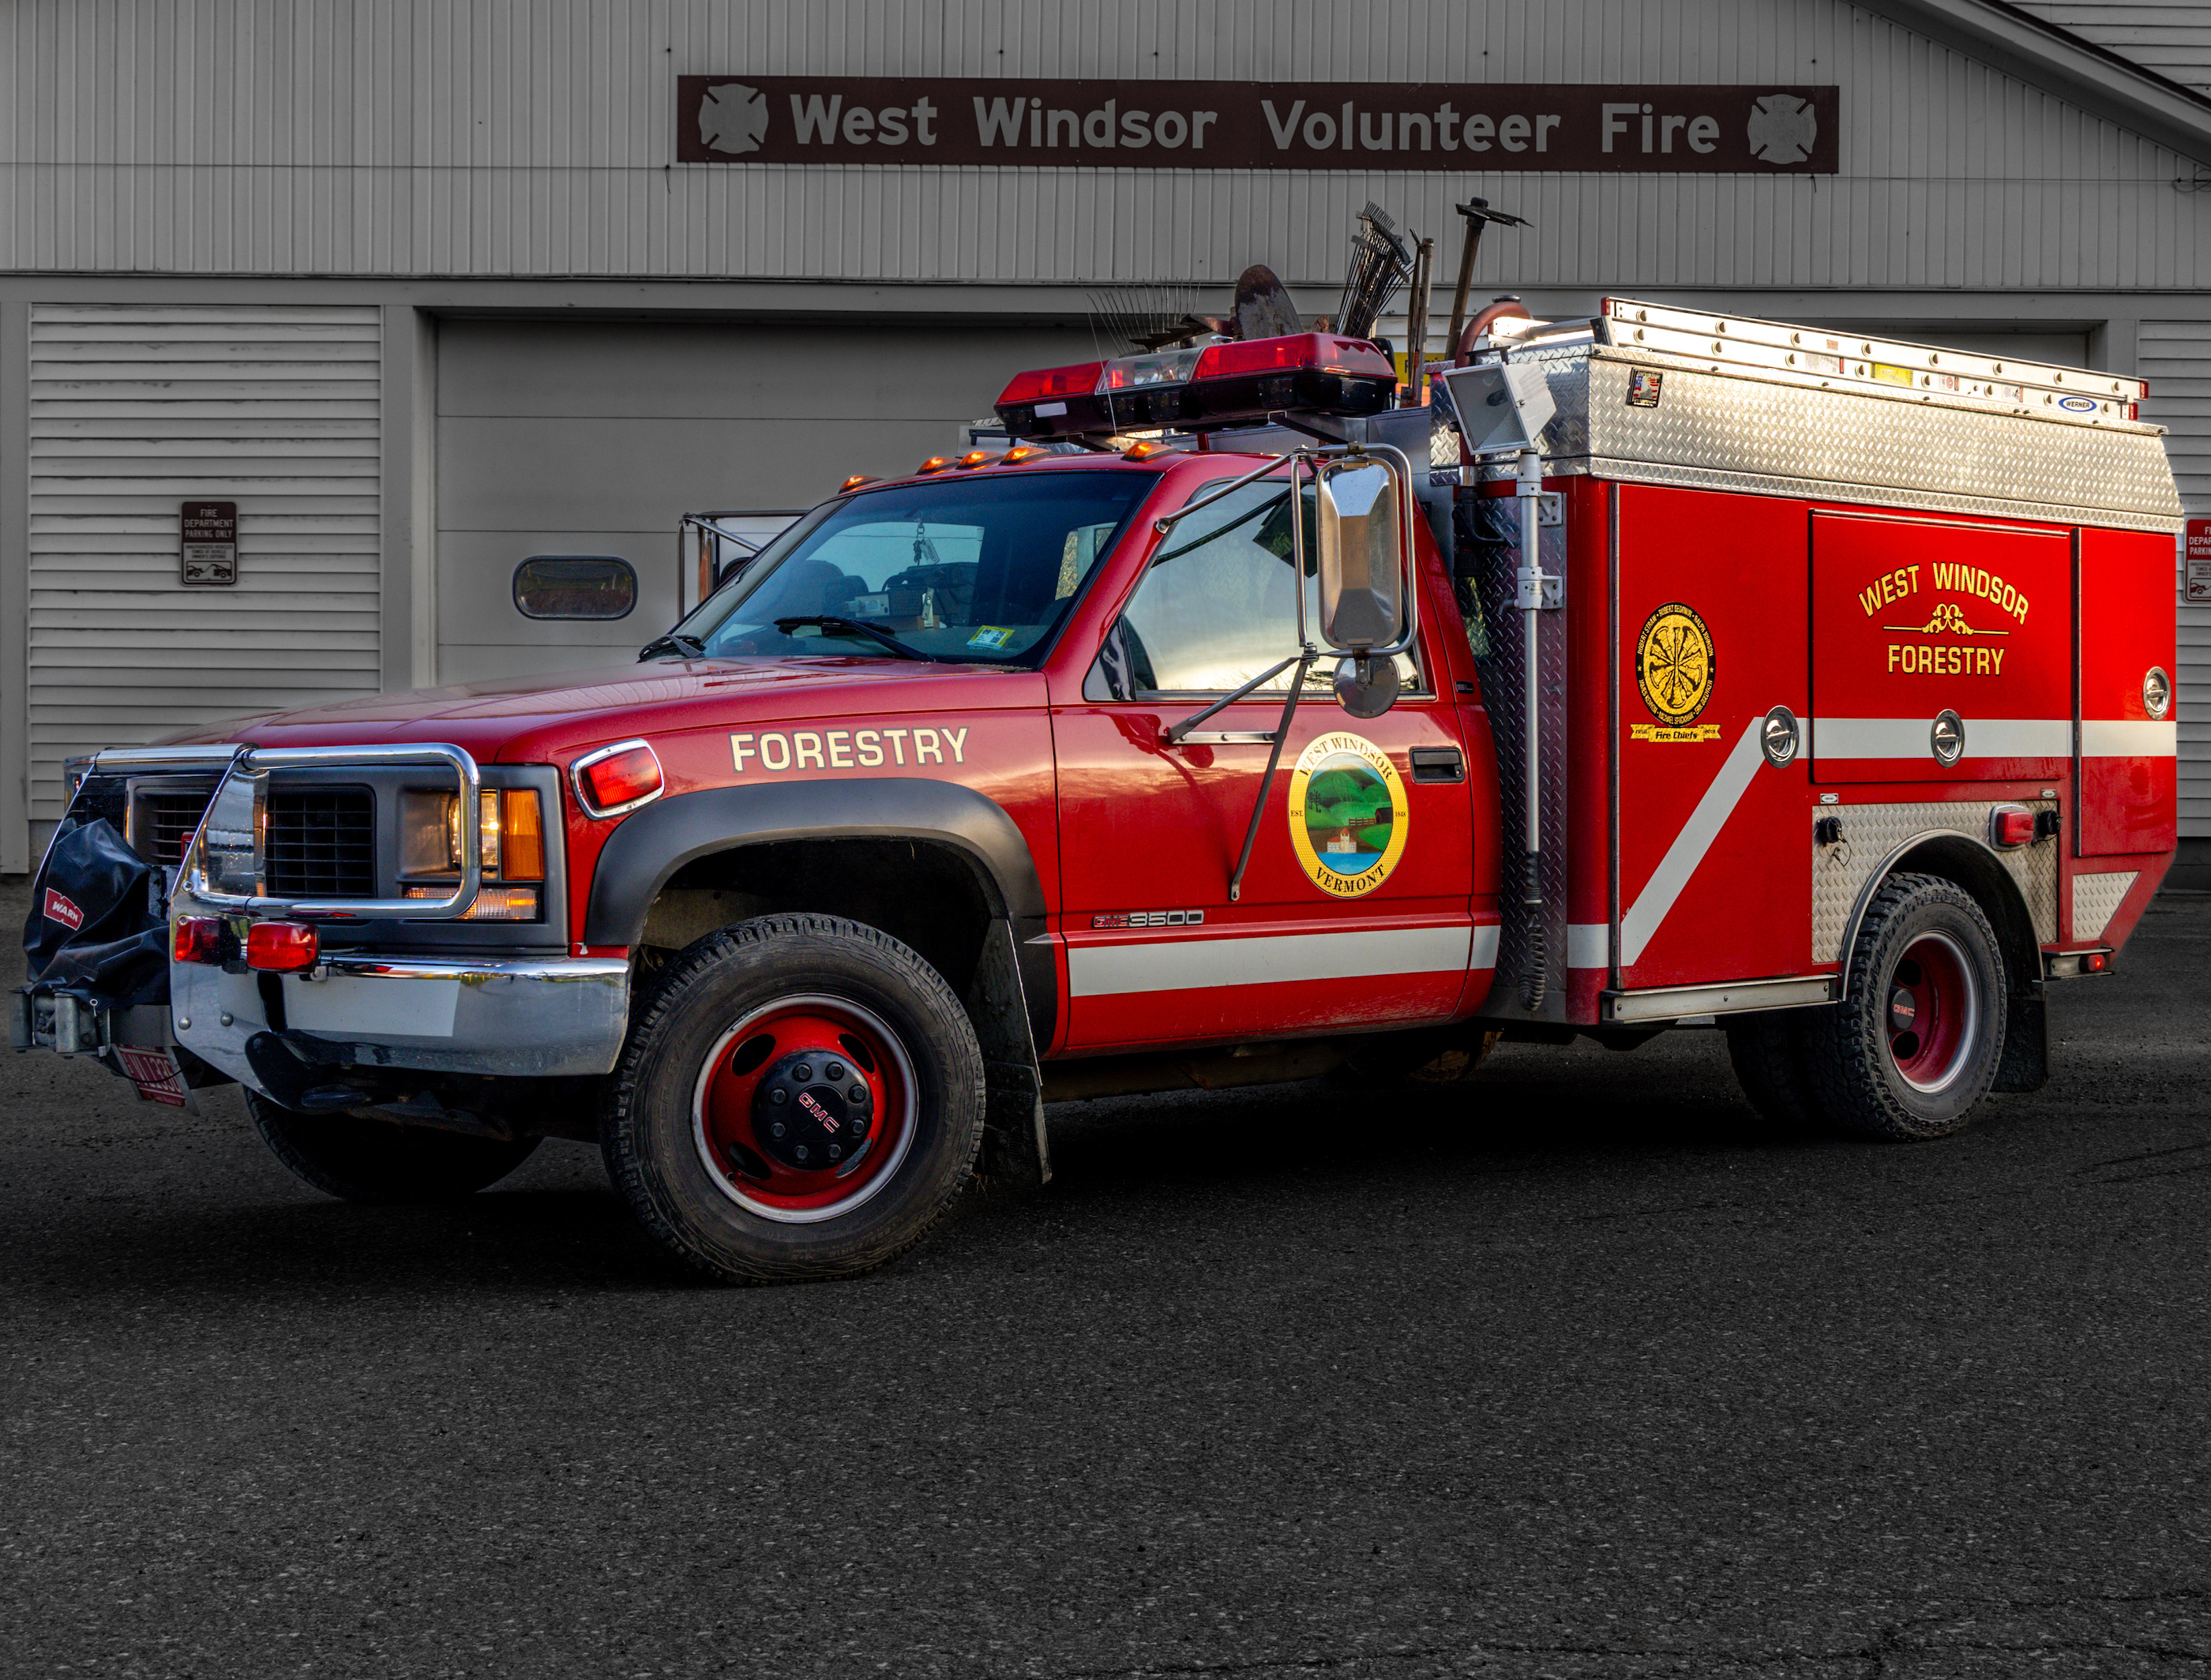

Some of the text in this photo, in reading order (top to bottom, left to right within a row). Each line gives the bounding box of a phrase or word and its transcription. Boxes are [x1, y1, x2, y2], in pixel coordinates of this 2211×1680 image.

[790, 94, 938, 146] West
[973, 96, 1218, 149] Windsor
[1260, 99, 1562, 153] Volunteer
[1601, 103, 1720, 155] Fire
[1857, 561, 2029, 626] WEST WINDSOR
[1637, 614, 1657, 654] ROBERT STRAW
[1887, 644, 2006, 676] FORESTRY
[730, 727, 968, 772] FORESTRY
[1299, 737, 1393, 781] WEST WINDSOR
[1316, 864, 1386, 893] VERMONT
[52, 901, 78, 922] WARN
[1894, 1003, 1915, 1018] GMC
[798, 1092, 840, 1134] GMC
